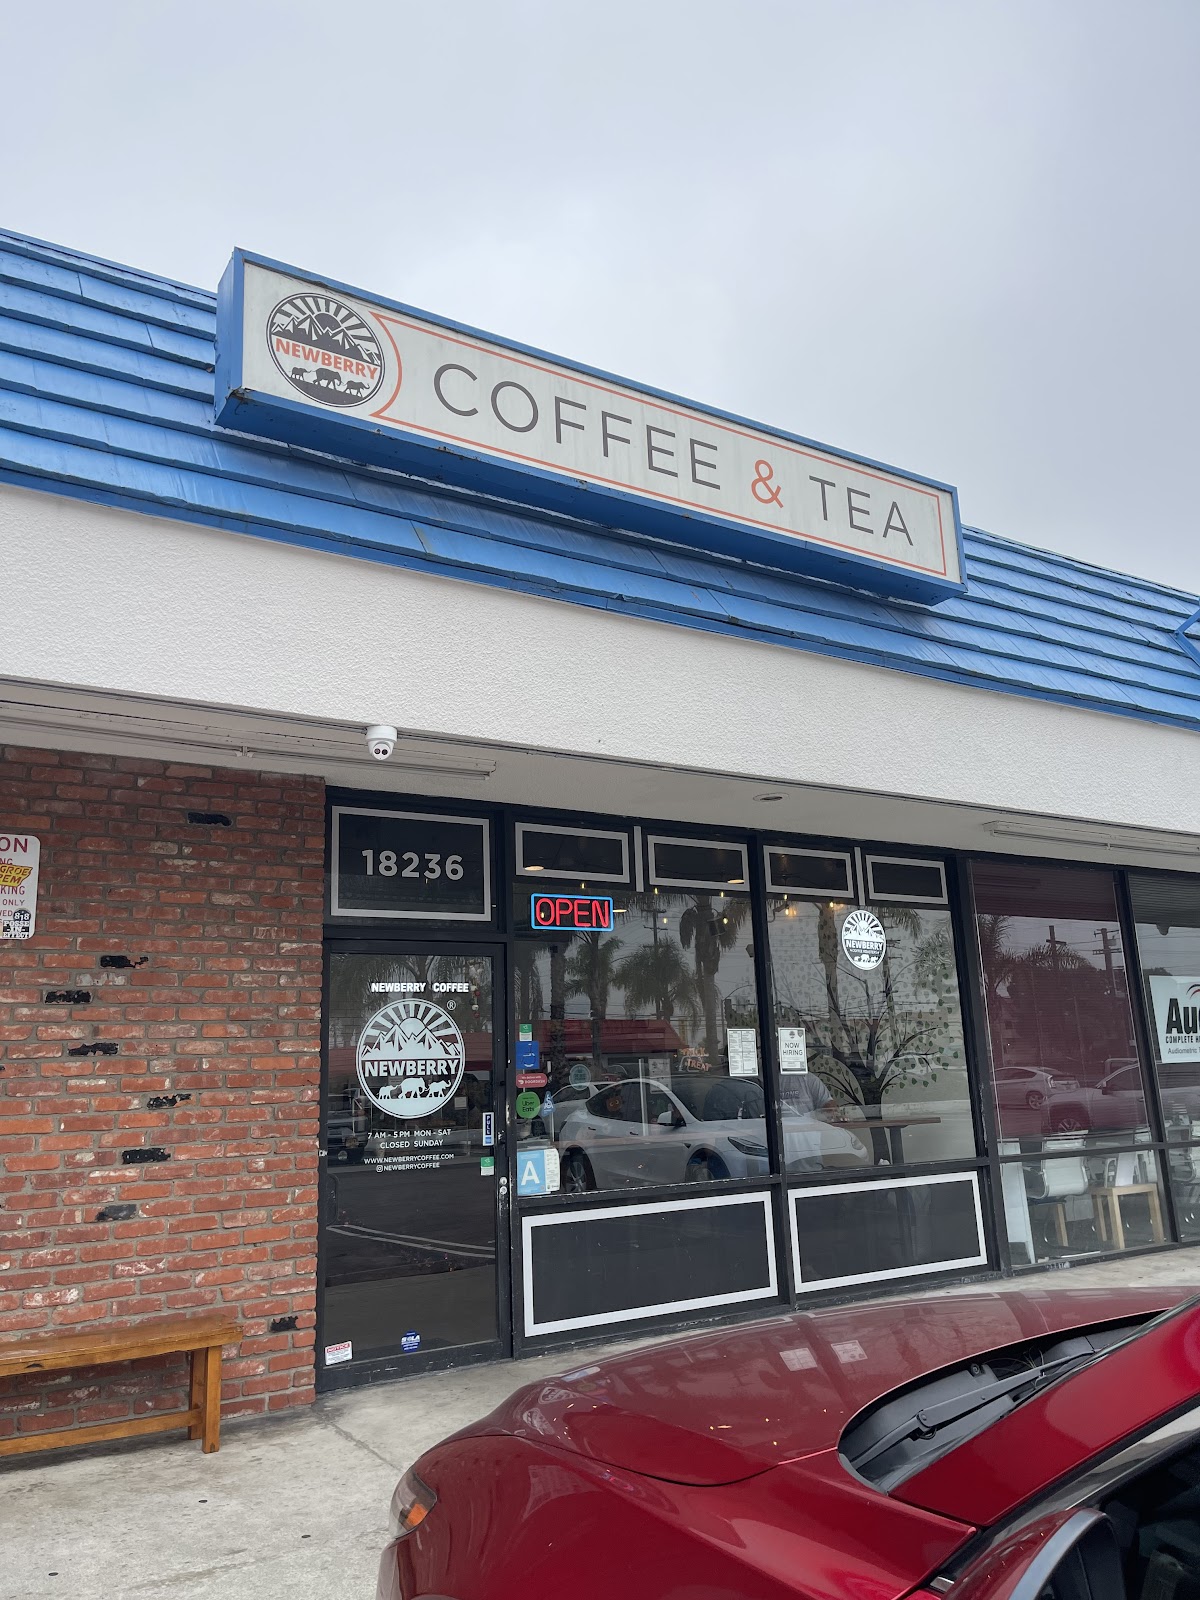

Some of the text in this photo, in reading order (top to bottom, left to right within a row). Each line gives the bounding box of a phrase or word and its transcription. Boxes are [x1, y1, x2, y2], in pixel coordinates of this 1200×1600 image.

[275, 337, 378, 380] NEWBERRY
[433, 363, 914, 547] COFFEE & TEA
[361, 849, 465, 881] 18236
[535, 897, 610, 928] OPEN
[845, 939, 884, 951] NEWBERRY
[371, 982, 470, 993] NEWBERRY COFFEE
[1165, 997, 1200, 1035] Au
[1165, 1035, 1194, 1044] COMPLETE
[1167, 1047, 1198, 1055] Audiometric
[363, 1059, 460, 1078] NEWBERRY
[367, 1132, 373, 1140] 7
[373, 1131, 386, 1139] AM
[393, 1131, 398, 1139] 5
[399, 1130, 411, 1138] PM
[413, 1129, 432, 1137] MON
[437, 1128, 452, 1136] SAT
[380, 1138, 444, 1149] CLOSED SUNDAY
[363, 1153, 455, 1165] WWW.NEWBERRYCOFFEE.COM
[520, 1160, 541, 1186] A
